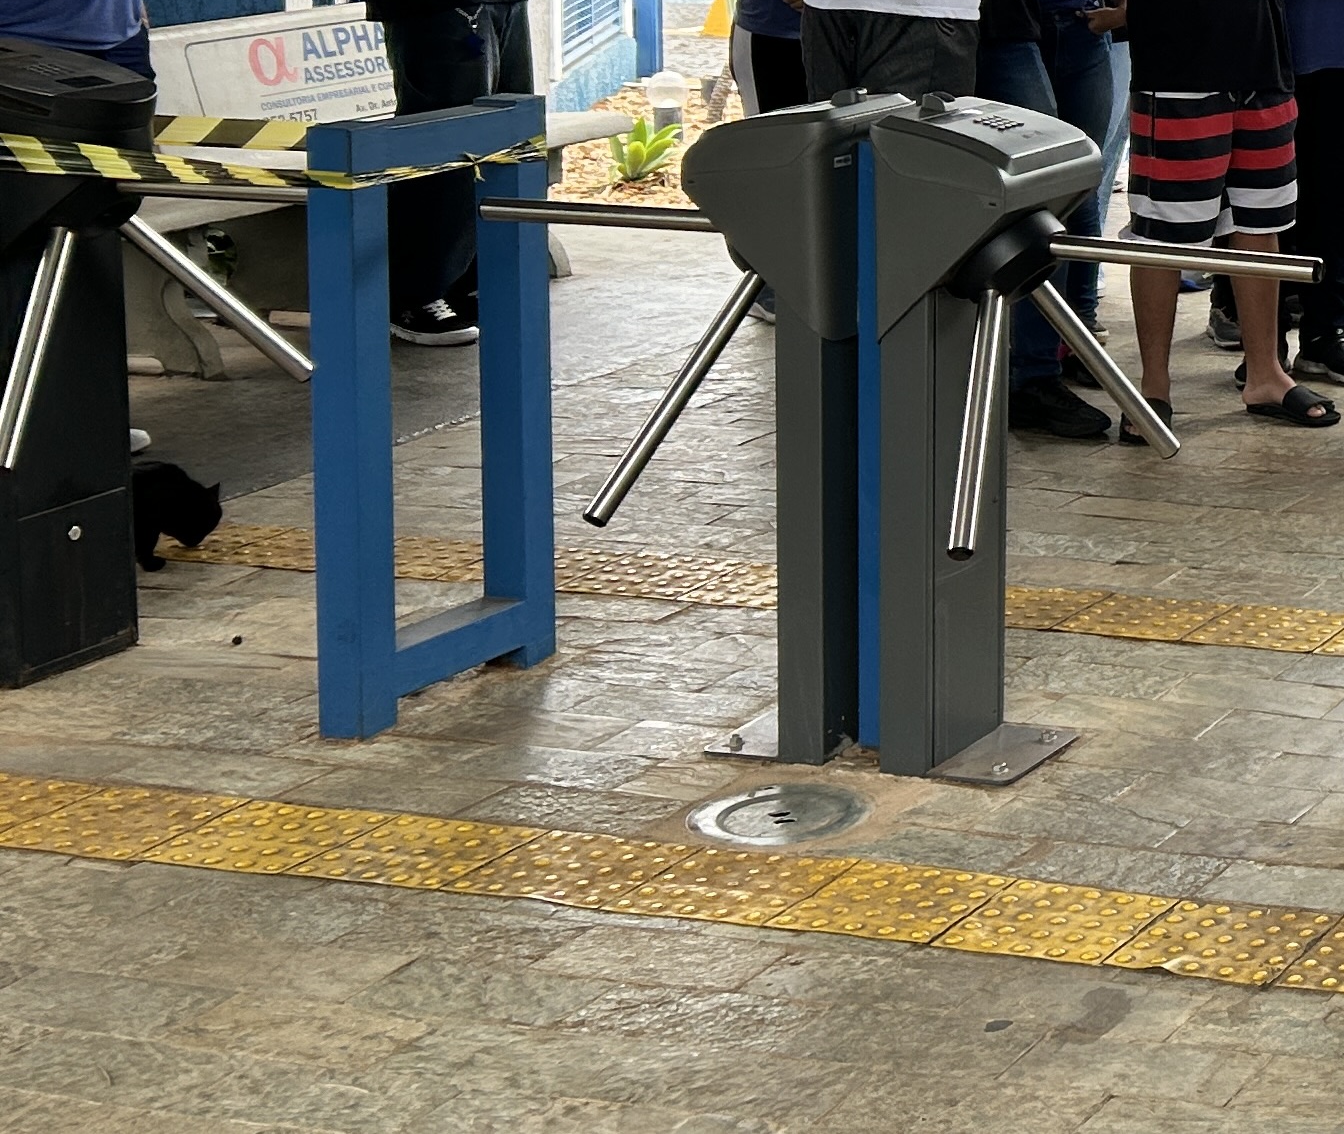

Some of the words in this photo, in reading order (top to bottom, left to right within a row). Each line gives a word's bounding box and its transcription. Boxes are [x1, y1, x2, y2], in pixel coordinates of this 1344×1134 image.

[302, 22, 386, 62] ALPHA
[304, 56, 388, 85] ASSESSOR
[261, 96, 316, 112] CONSULTORIA
[317, 85, 371, 102] EMPRESARIAL
